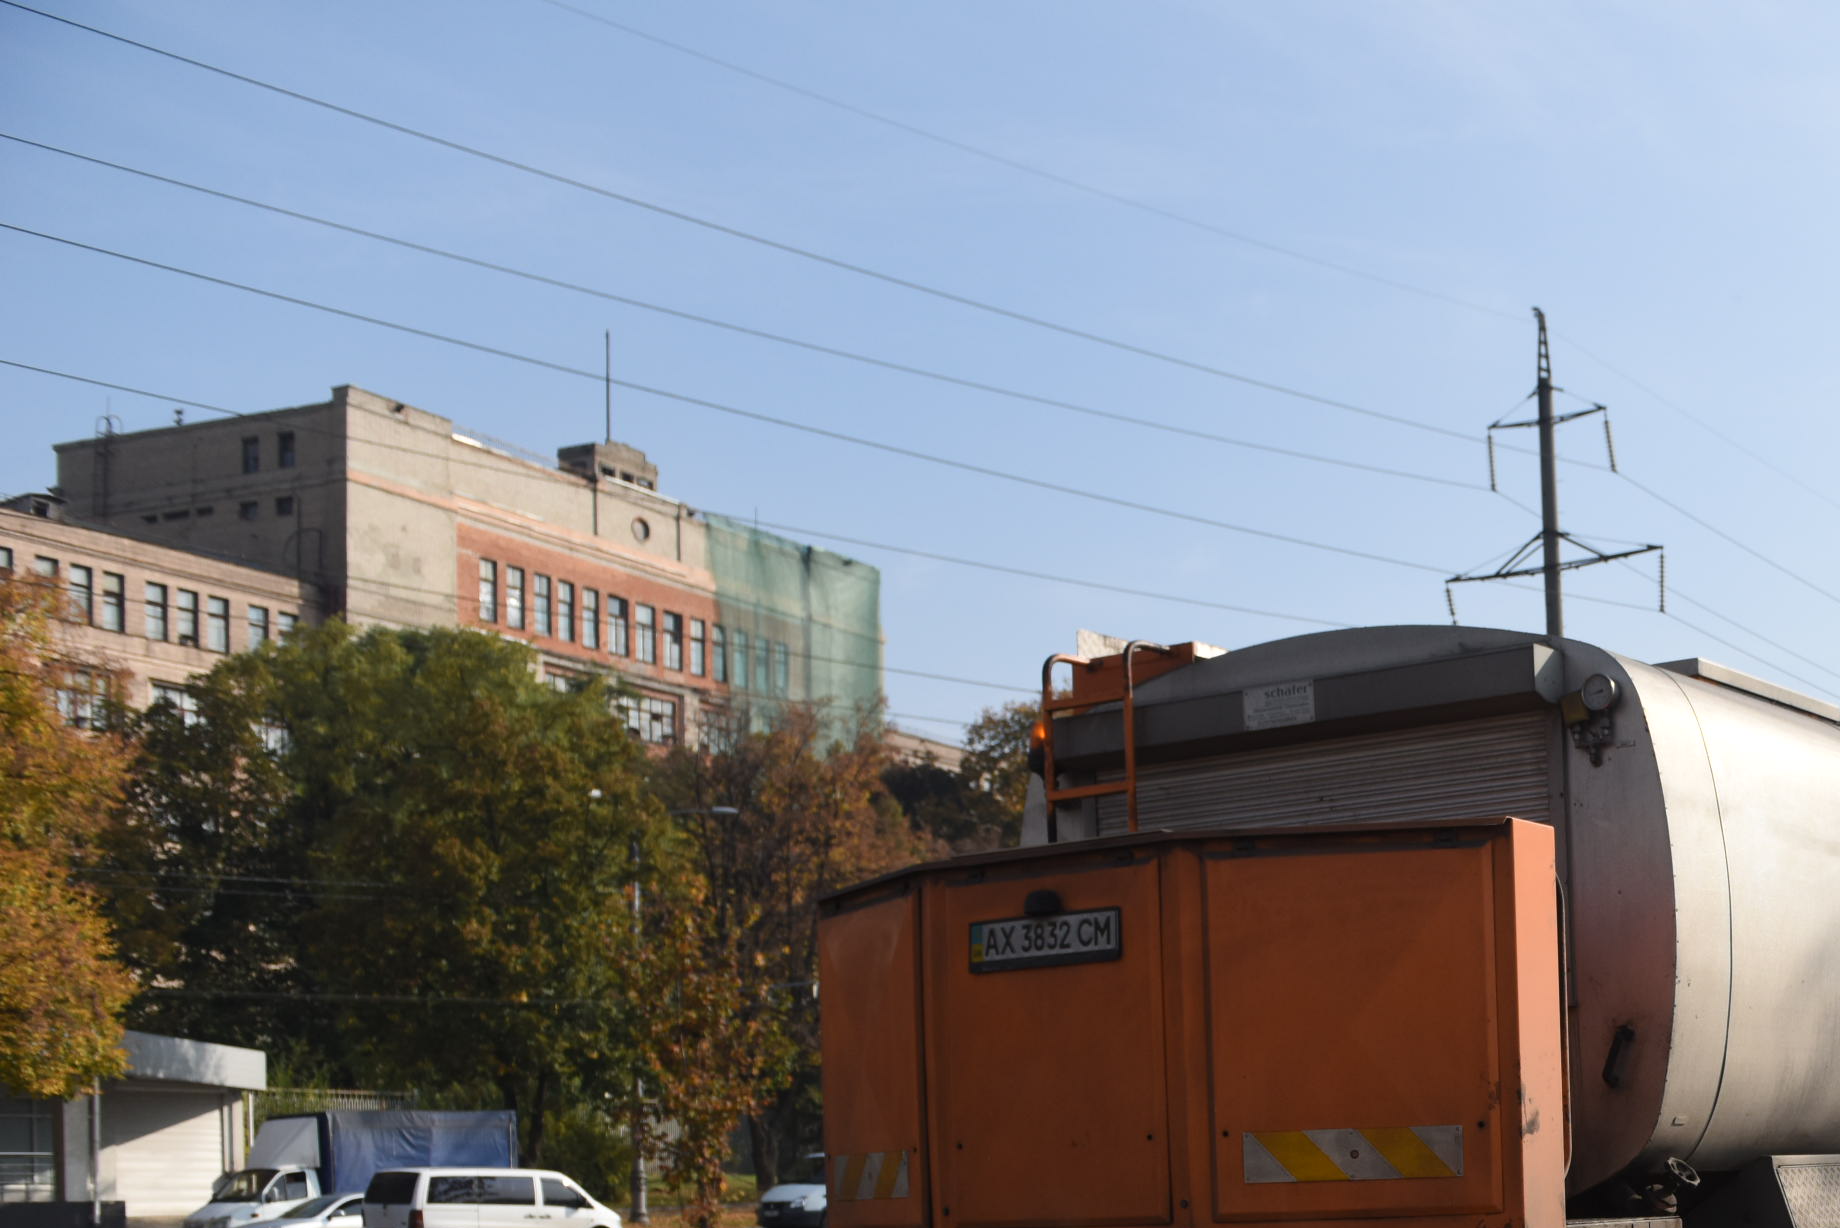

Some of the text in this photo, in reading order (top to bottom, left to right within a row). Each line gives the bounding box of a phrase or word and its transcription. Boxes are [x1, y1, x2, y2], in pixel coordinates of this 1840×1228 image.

[985, 914, 1112, 957] AX 3832 CM
